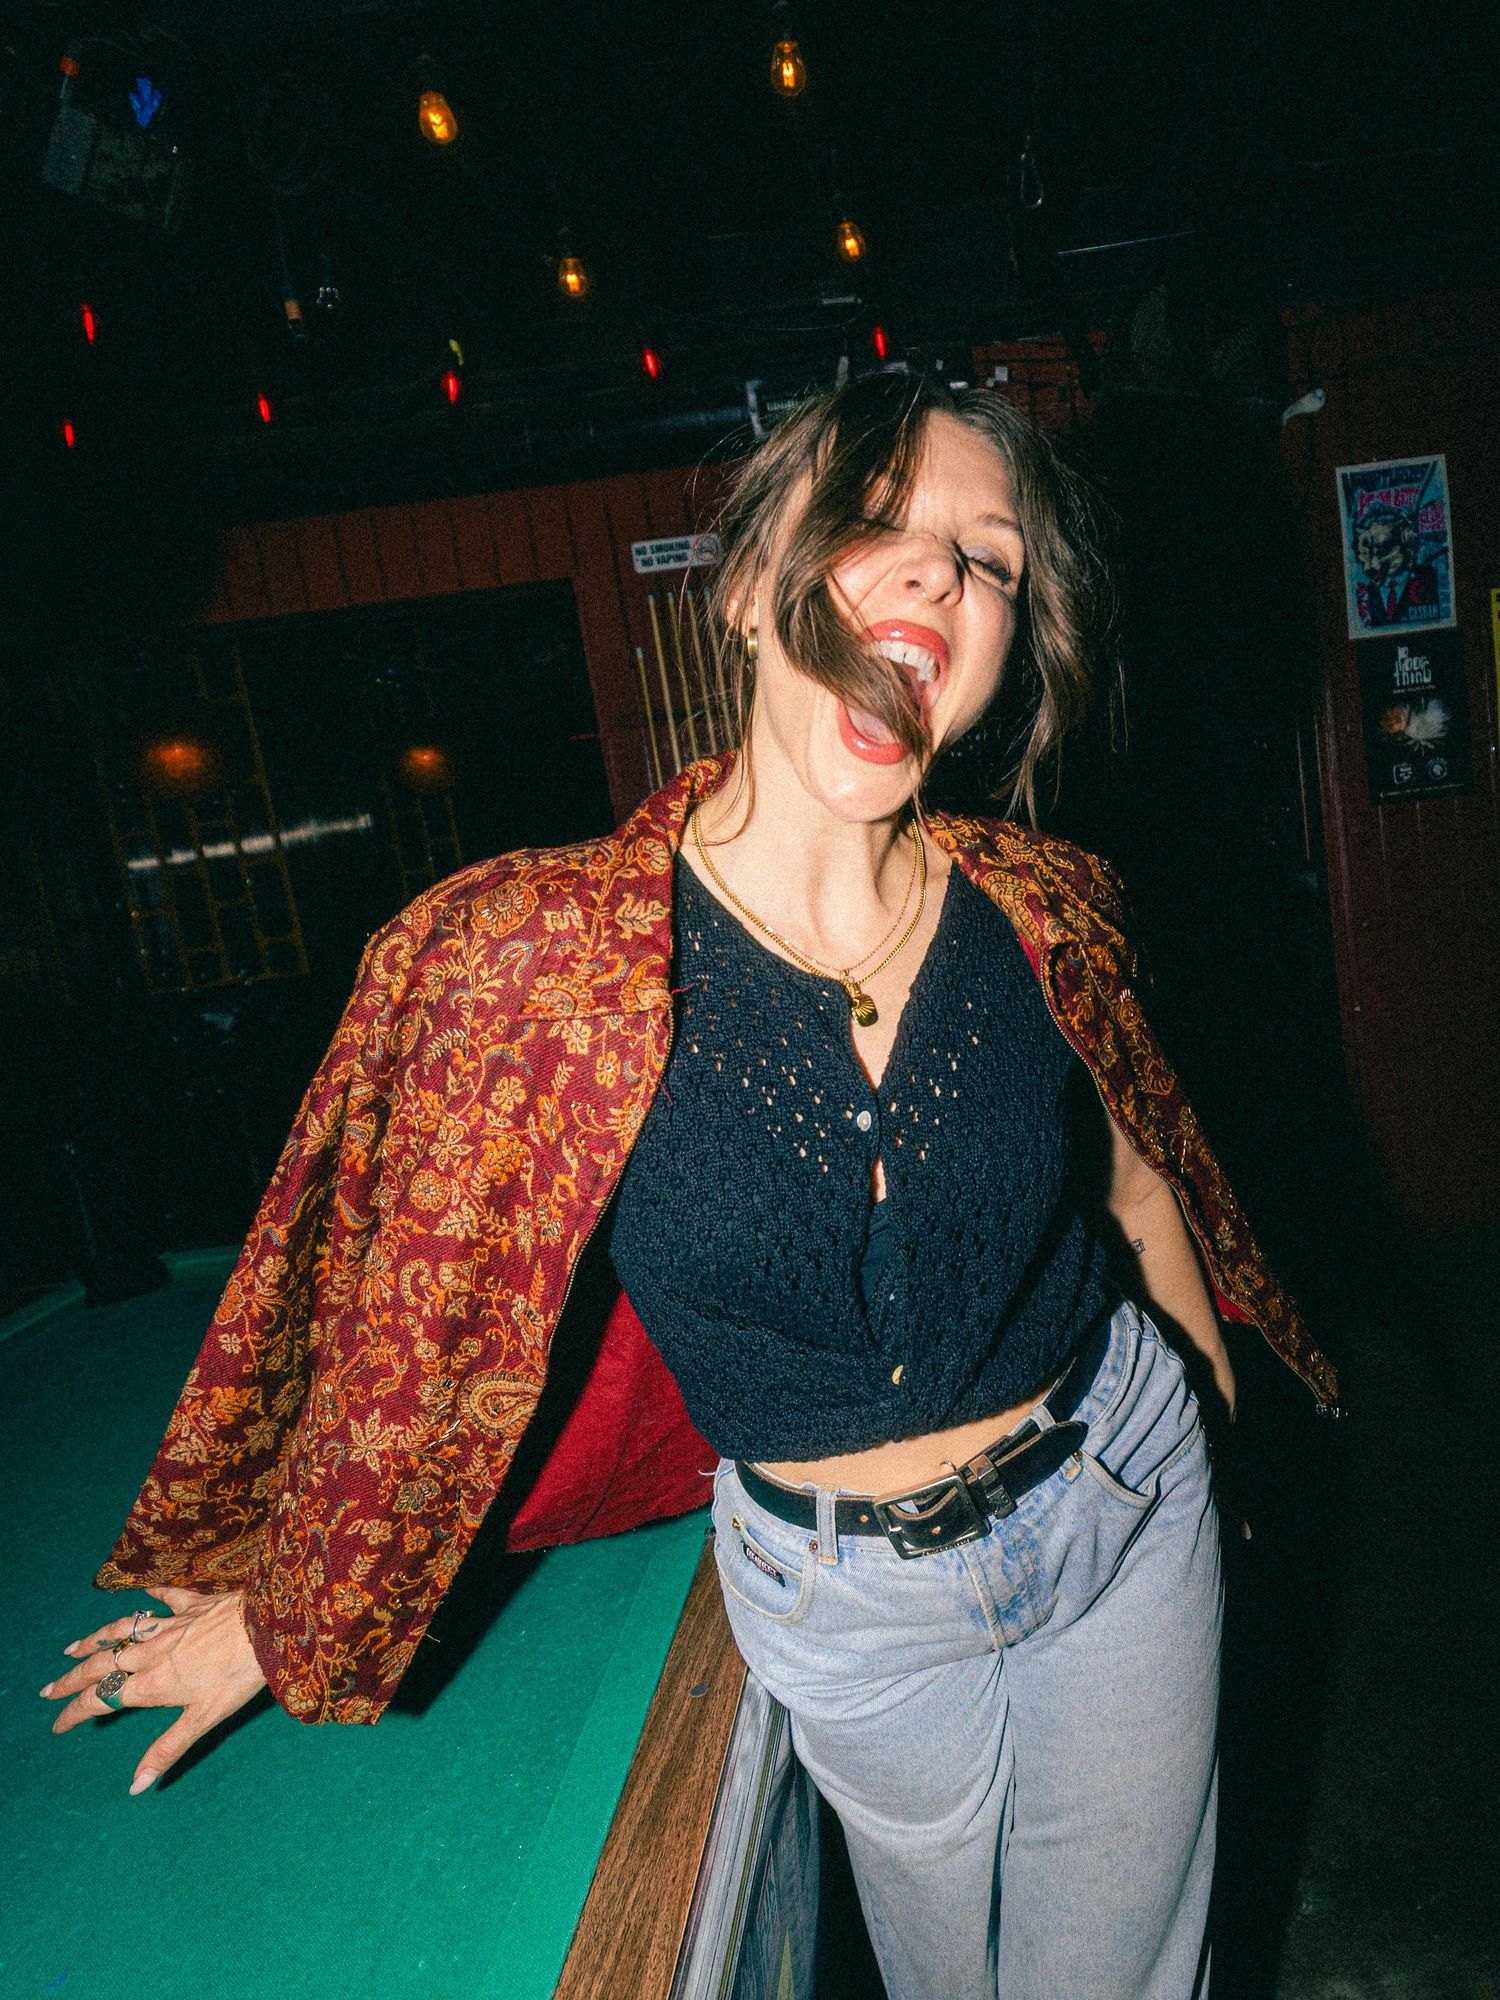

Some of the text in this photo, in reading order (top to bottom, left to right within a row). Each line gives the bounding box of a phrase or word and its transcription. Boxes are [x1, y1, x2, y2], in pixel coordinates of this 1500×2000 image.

[635, 540, 690, 556] NO SMOKING
[641, 552, 688, 567] NO VAPING
